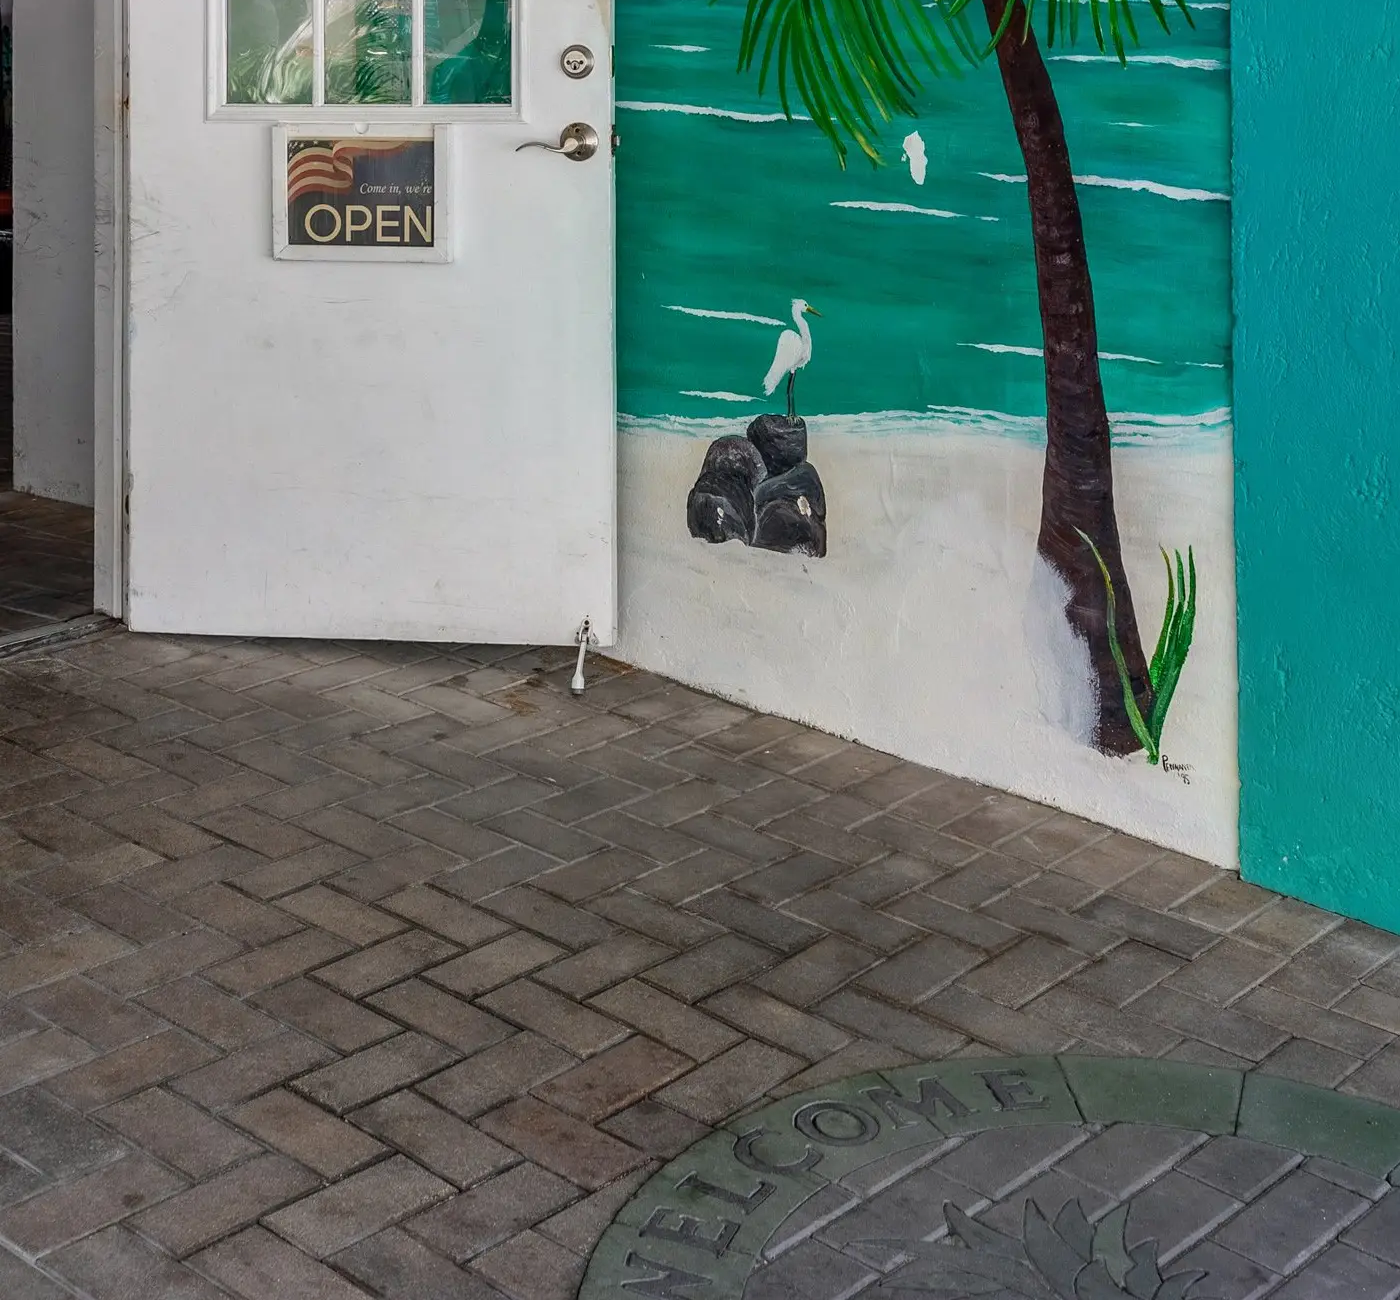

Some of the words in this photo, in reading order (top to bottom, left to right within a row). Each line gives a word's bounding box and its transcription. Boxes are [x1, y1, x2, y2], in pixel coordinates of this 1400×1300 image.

[359, 182, 387, 195] Come
[389, 182, 401, 196] in,
[405, 182, 433, 195] we're
[304, 203, 432, 243] OPEN
